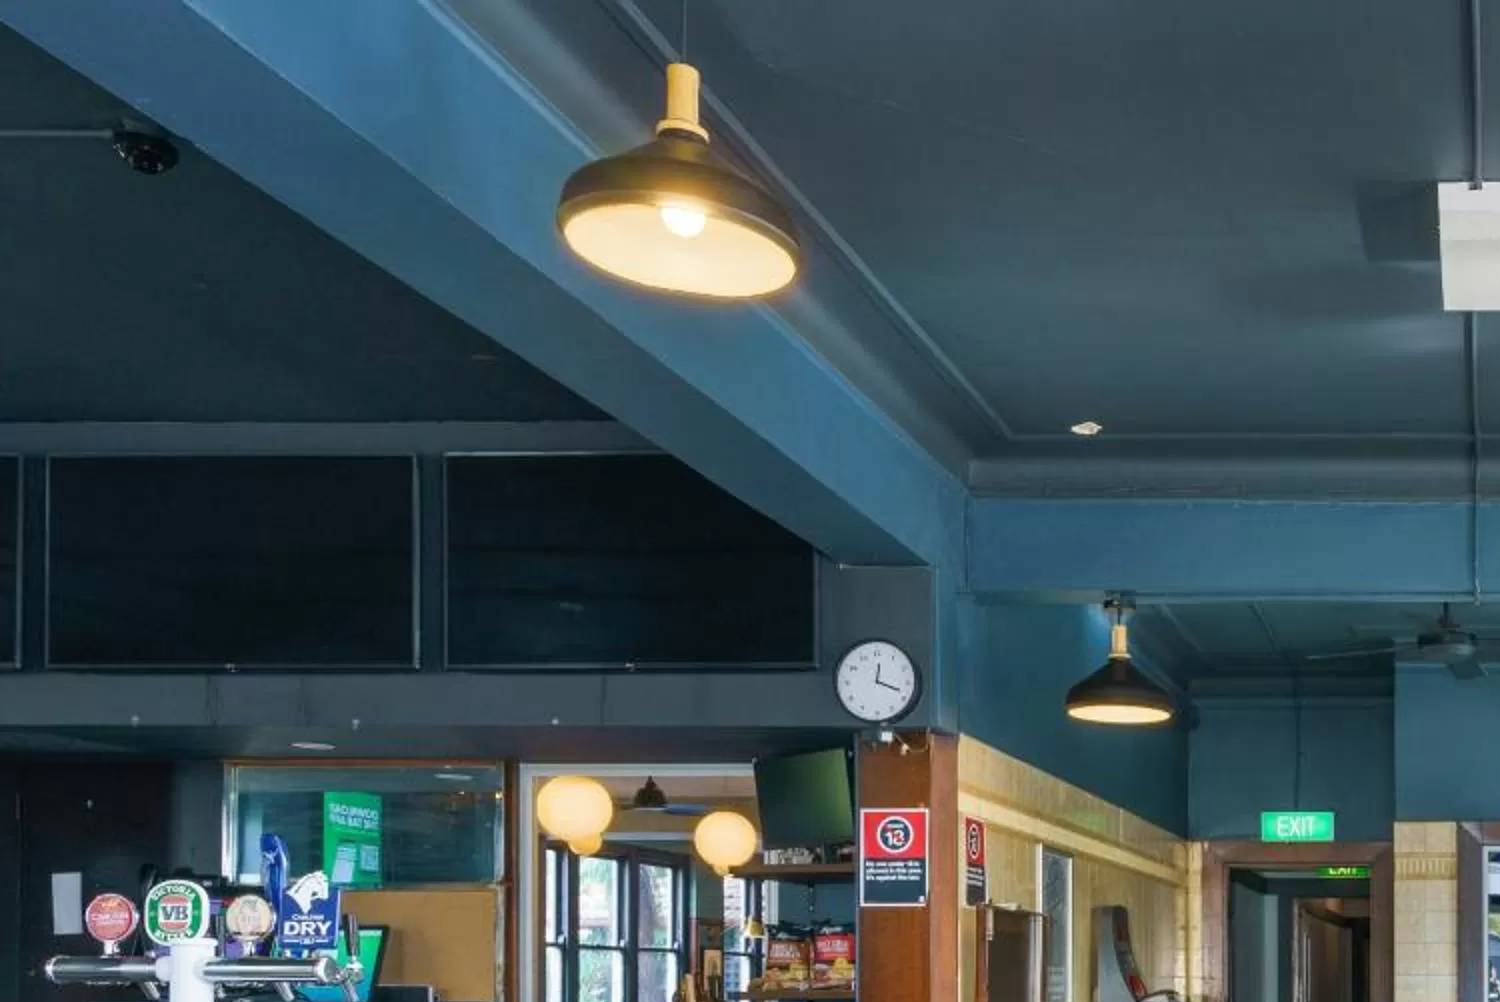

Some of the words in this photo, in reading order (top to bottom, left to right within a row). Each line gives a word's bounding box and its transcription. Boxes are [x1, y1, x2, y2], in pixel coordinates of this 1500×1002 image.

[1277, 816, 1314, 837] EXIT
[885, 829, 906, 847] 18
[160, 905, 189, 921] VB
[283, 920, 333, 936] DRY
